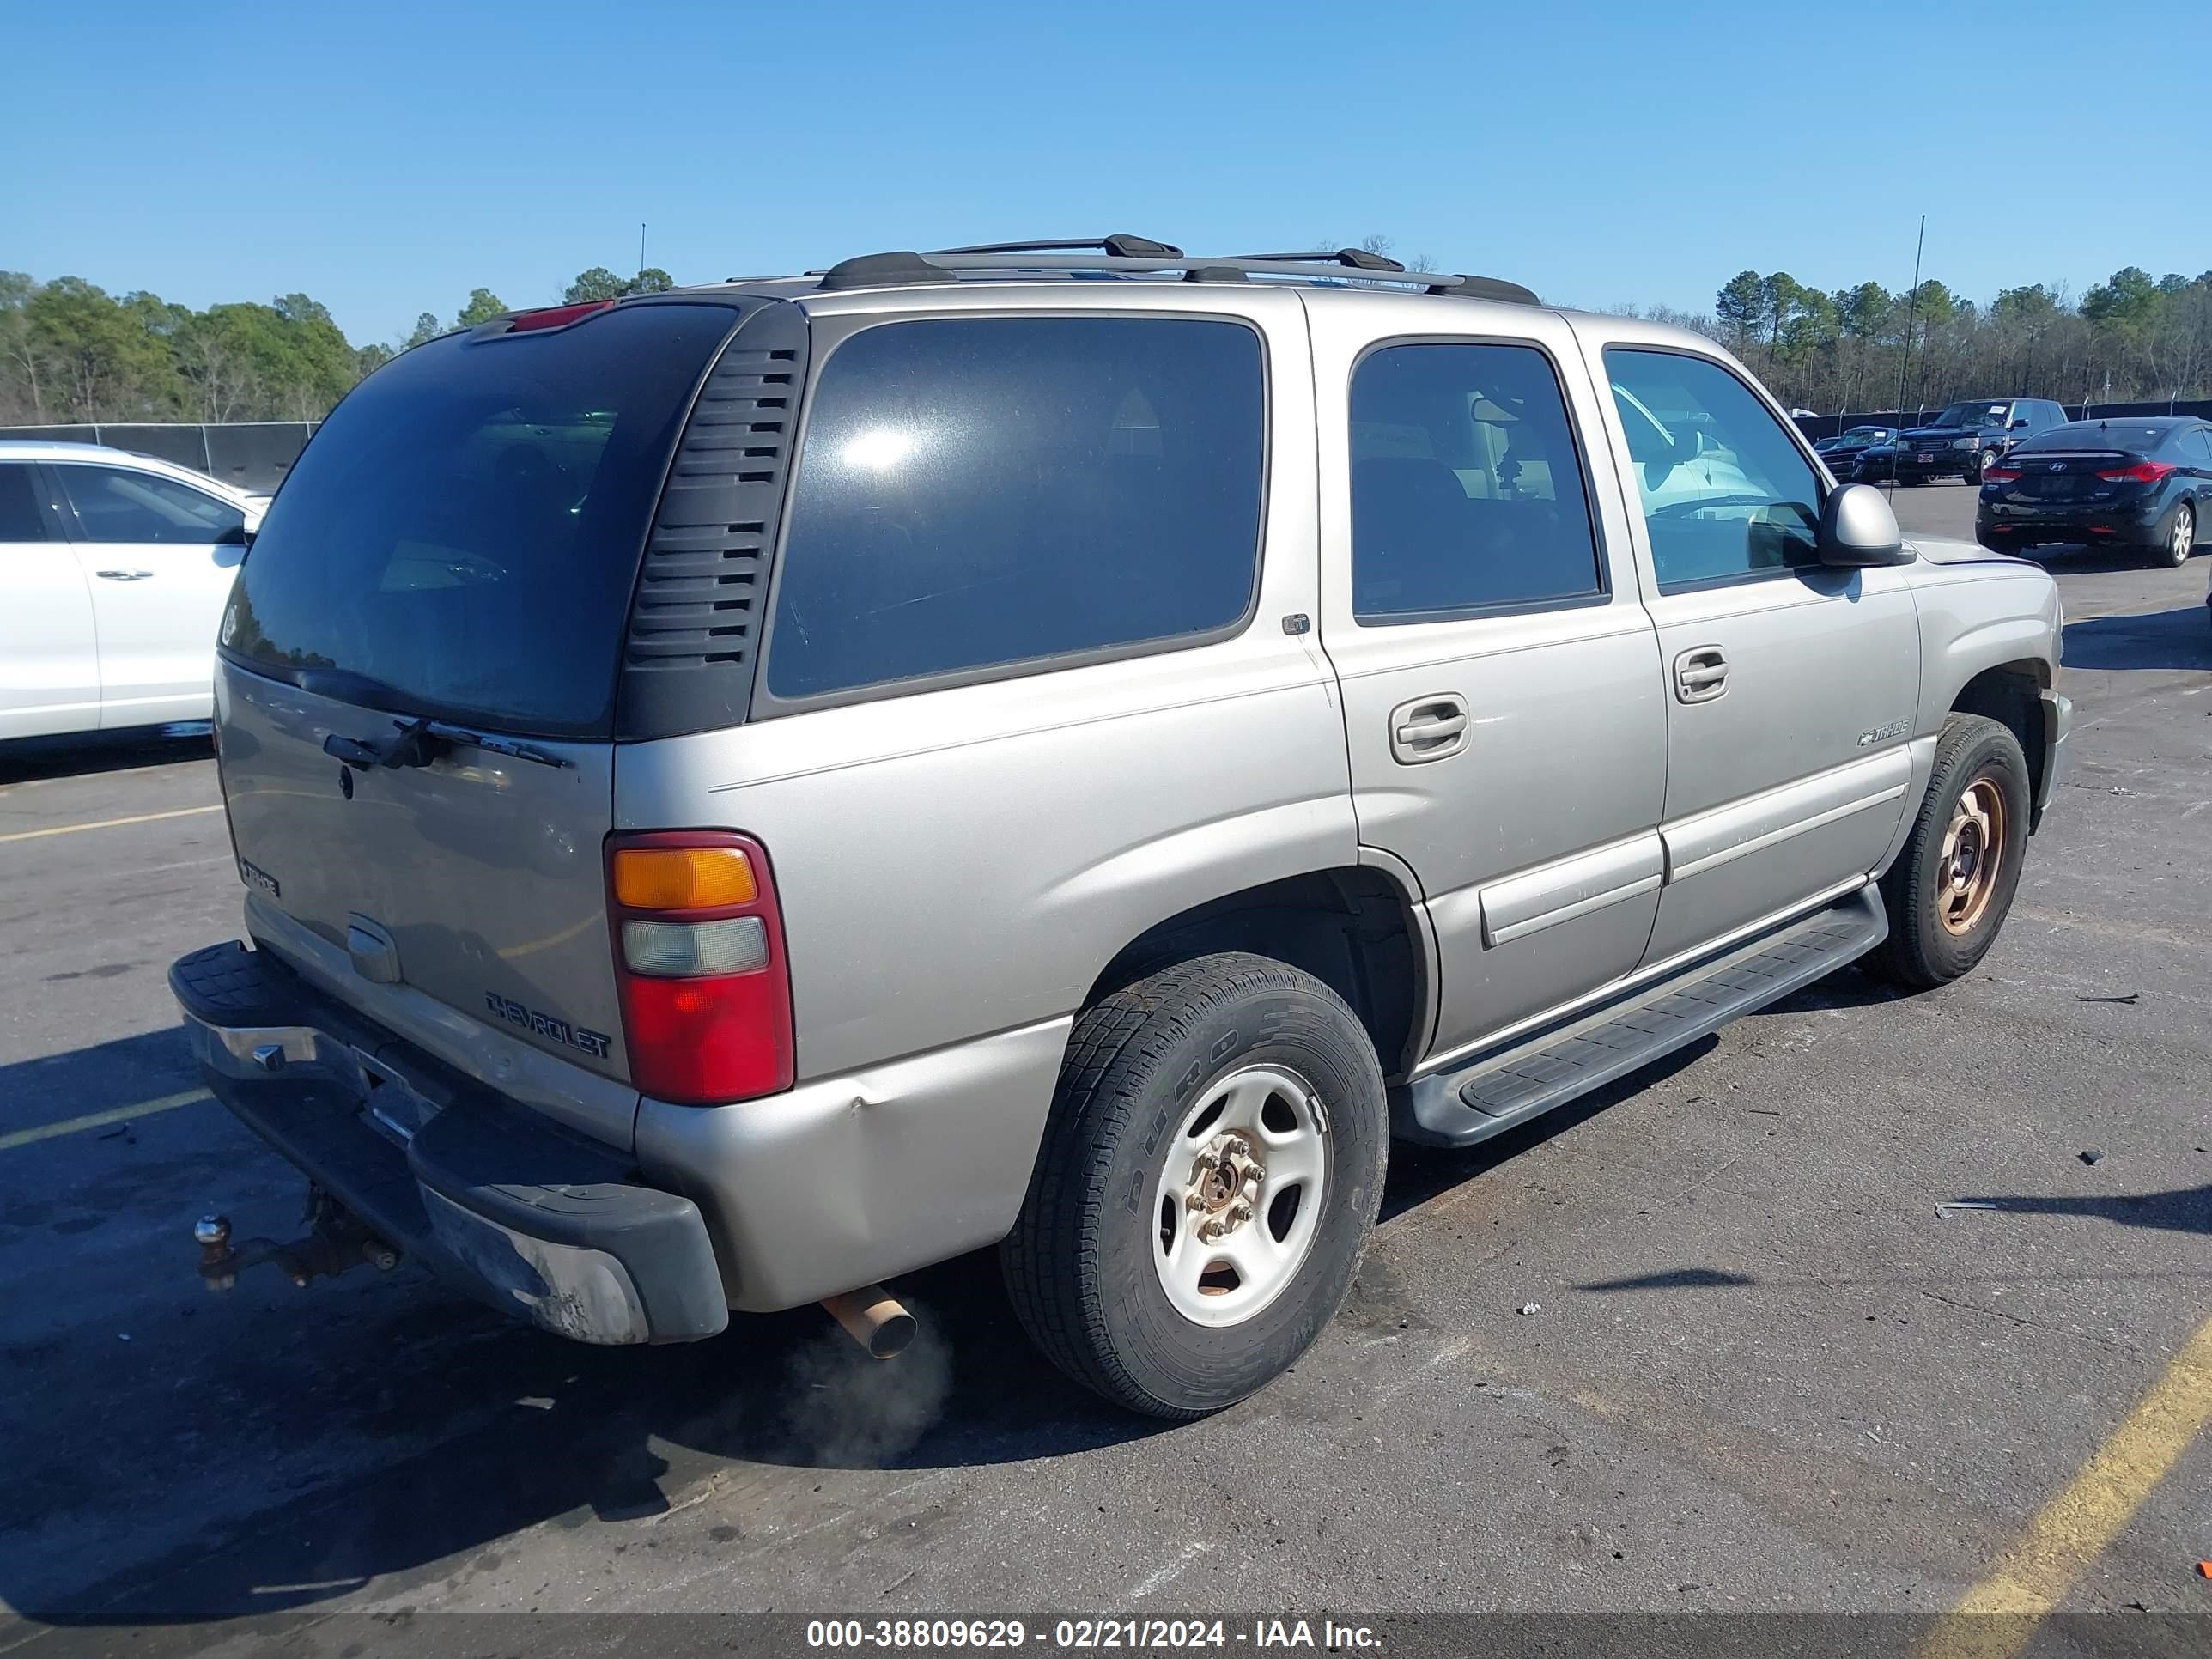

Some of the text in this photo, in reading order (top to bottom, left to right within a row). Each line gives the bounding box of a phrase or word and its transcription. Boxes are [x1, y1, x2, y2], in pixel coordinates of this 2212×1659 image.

[1874, 720, 1909, 741] TAHOE
[484, 991, 612, 1059] CHEVROLET
[1126, 1029, 1239, 1217] DURO
